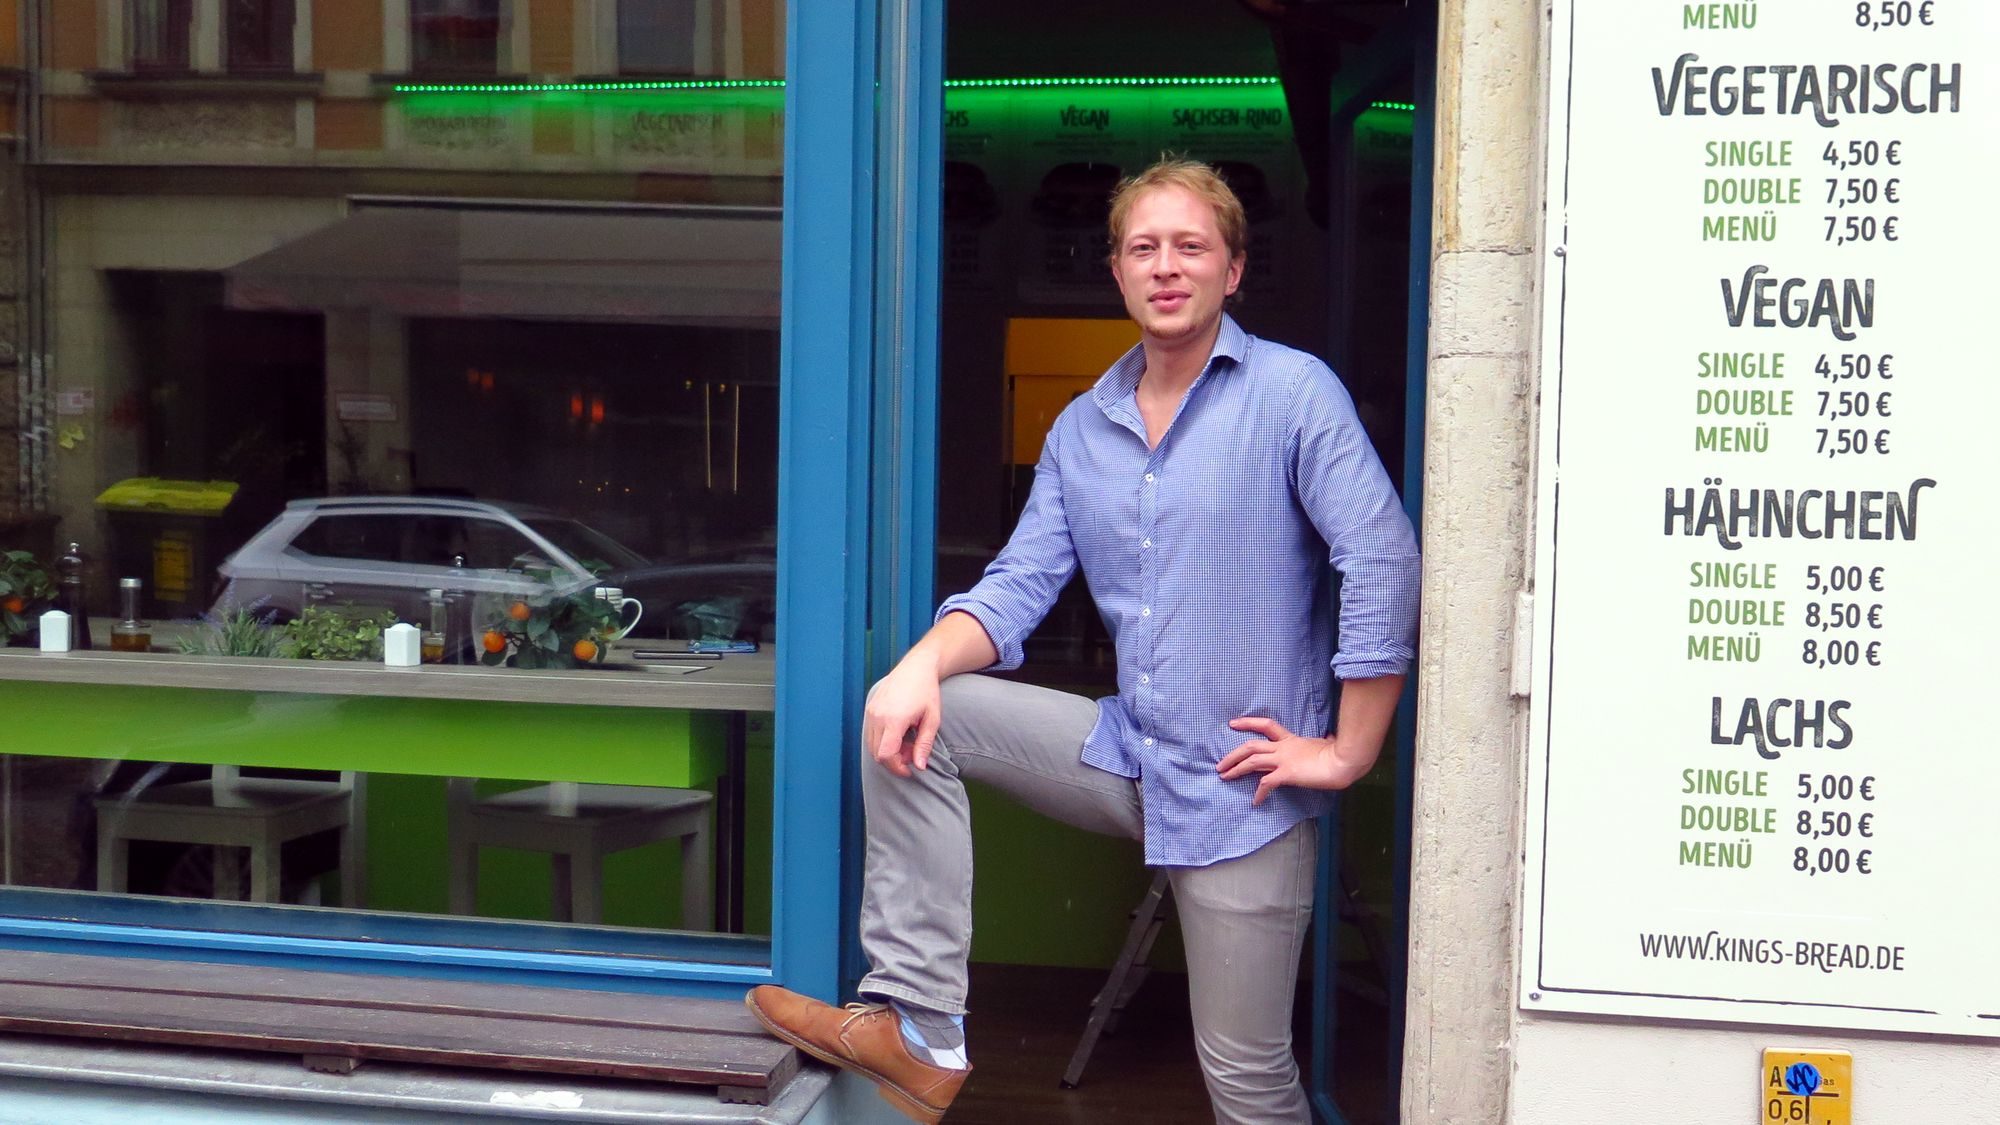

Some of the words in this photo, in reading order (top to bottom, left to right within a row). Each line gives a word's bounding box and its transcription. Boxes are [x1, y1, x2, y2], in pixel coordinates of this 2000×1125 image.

[1683, 0, 1757, 30] MENÜ
[1855, 0, 1912, 32] 8,50
[1918, 0, 1935, 26] €
[1650, 52, 1962, 129] VEGETARISCH
[1060, 105, 1110, 131] VEGAN
[1172, 107, 1282, 130] SACHSEN-RIND
[1705, 140, 1793, 167] SINGLE
[1822, 140, 1879, 171] 4,50
[1885, 139, 1902, 166] €
[1703, 178, 1802, 205] DOUBLE
[1825, 177, 1878, 209] 7,50
[1883, 177, 1901, 204] €
[1702, 210, 1777, 242] MENÜ
[1823, 215, 1877, 247] 7,50
[1882, 215, 1899, 242] €
[1720, 264, 1875, 342] VEGAN
[1697, 351, 1785, 379] SINGLE
[1814, 353, 1871, 384] 4,50
[1877, 353, 1894, 380] €
[1696, 389, 1794, 416] DOUBLE
[1817, 390, 1870, 422] 7,50
[1875, 391, 1893, 418] €
[1695, 421, 1769, 453] MENÜ
[1815, 428, 1868, 459] 7,50
[1873, 428, 1891, 455] €
[1663, 477, 1938, 551] HÄHNCHEN
[1689, 561, 1777, 590] SINGLE
[1806, 565, 1863, 596] 5,00
[1868, 566, 1885, 593] €
[1688, 598, 1786, 627] DOUBLE
[1805, 601, 1861, 633] 8,50
[1866, 603, 1884, 630] €
[1687, 631, 1761, 663] MENÜ
[1801, 638, 1860, 670] 8,00
[1865, 640, 1882, 667] €
[1710, 696, 1854, 761] LACHS
[1681, 768, 1769, 797] SINGLE
[1797, 773, 1854, 804] 5,00
[1859, 775, 1876, 802] €
[1680, 804, 1777, 834] DOUBLE
[1796, 809, 1852, 841] 8,50
[1857, 812, 1874, 838] €
[1679, 838, 1752, 869] MENÜ
[1792, 846, 1850, 877] 8,00
[1855, 849, 1873, 875] €
[1639, 930, 1905, 974] WWW.KINGS-BREAD.DE
[1768, 1098, 1804, 1124] 0,6
